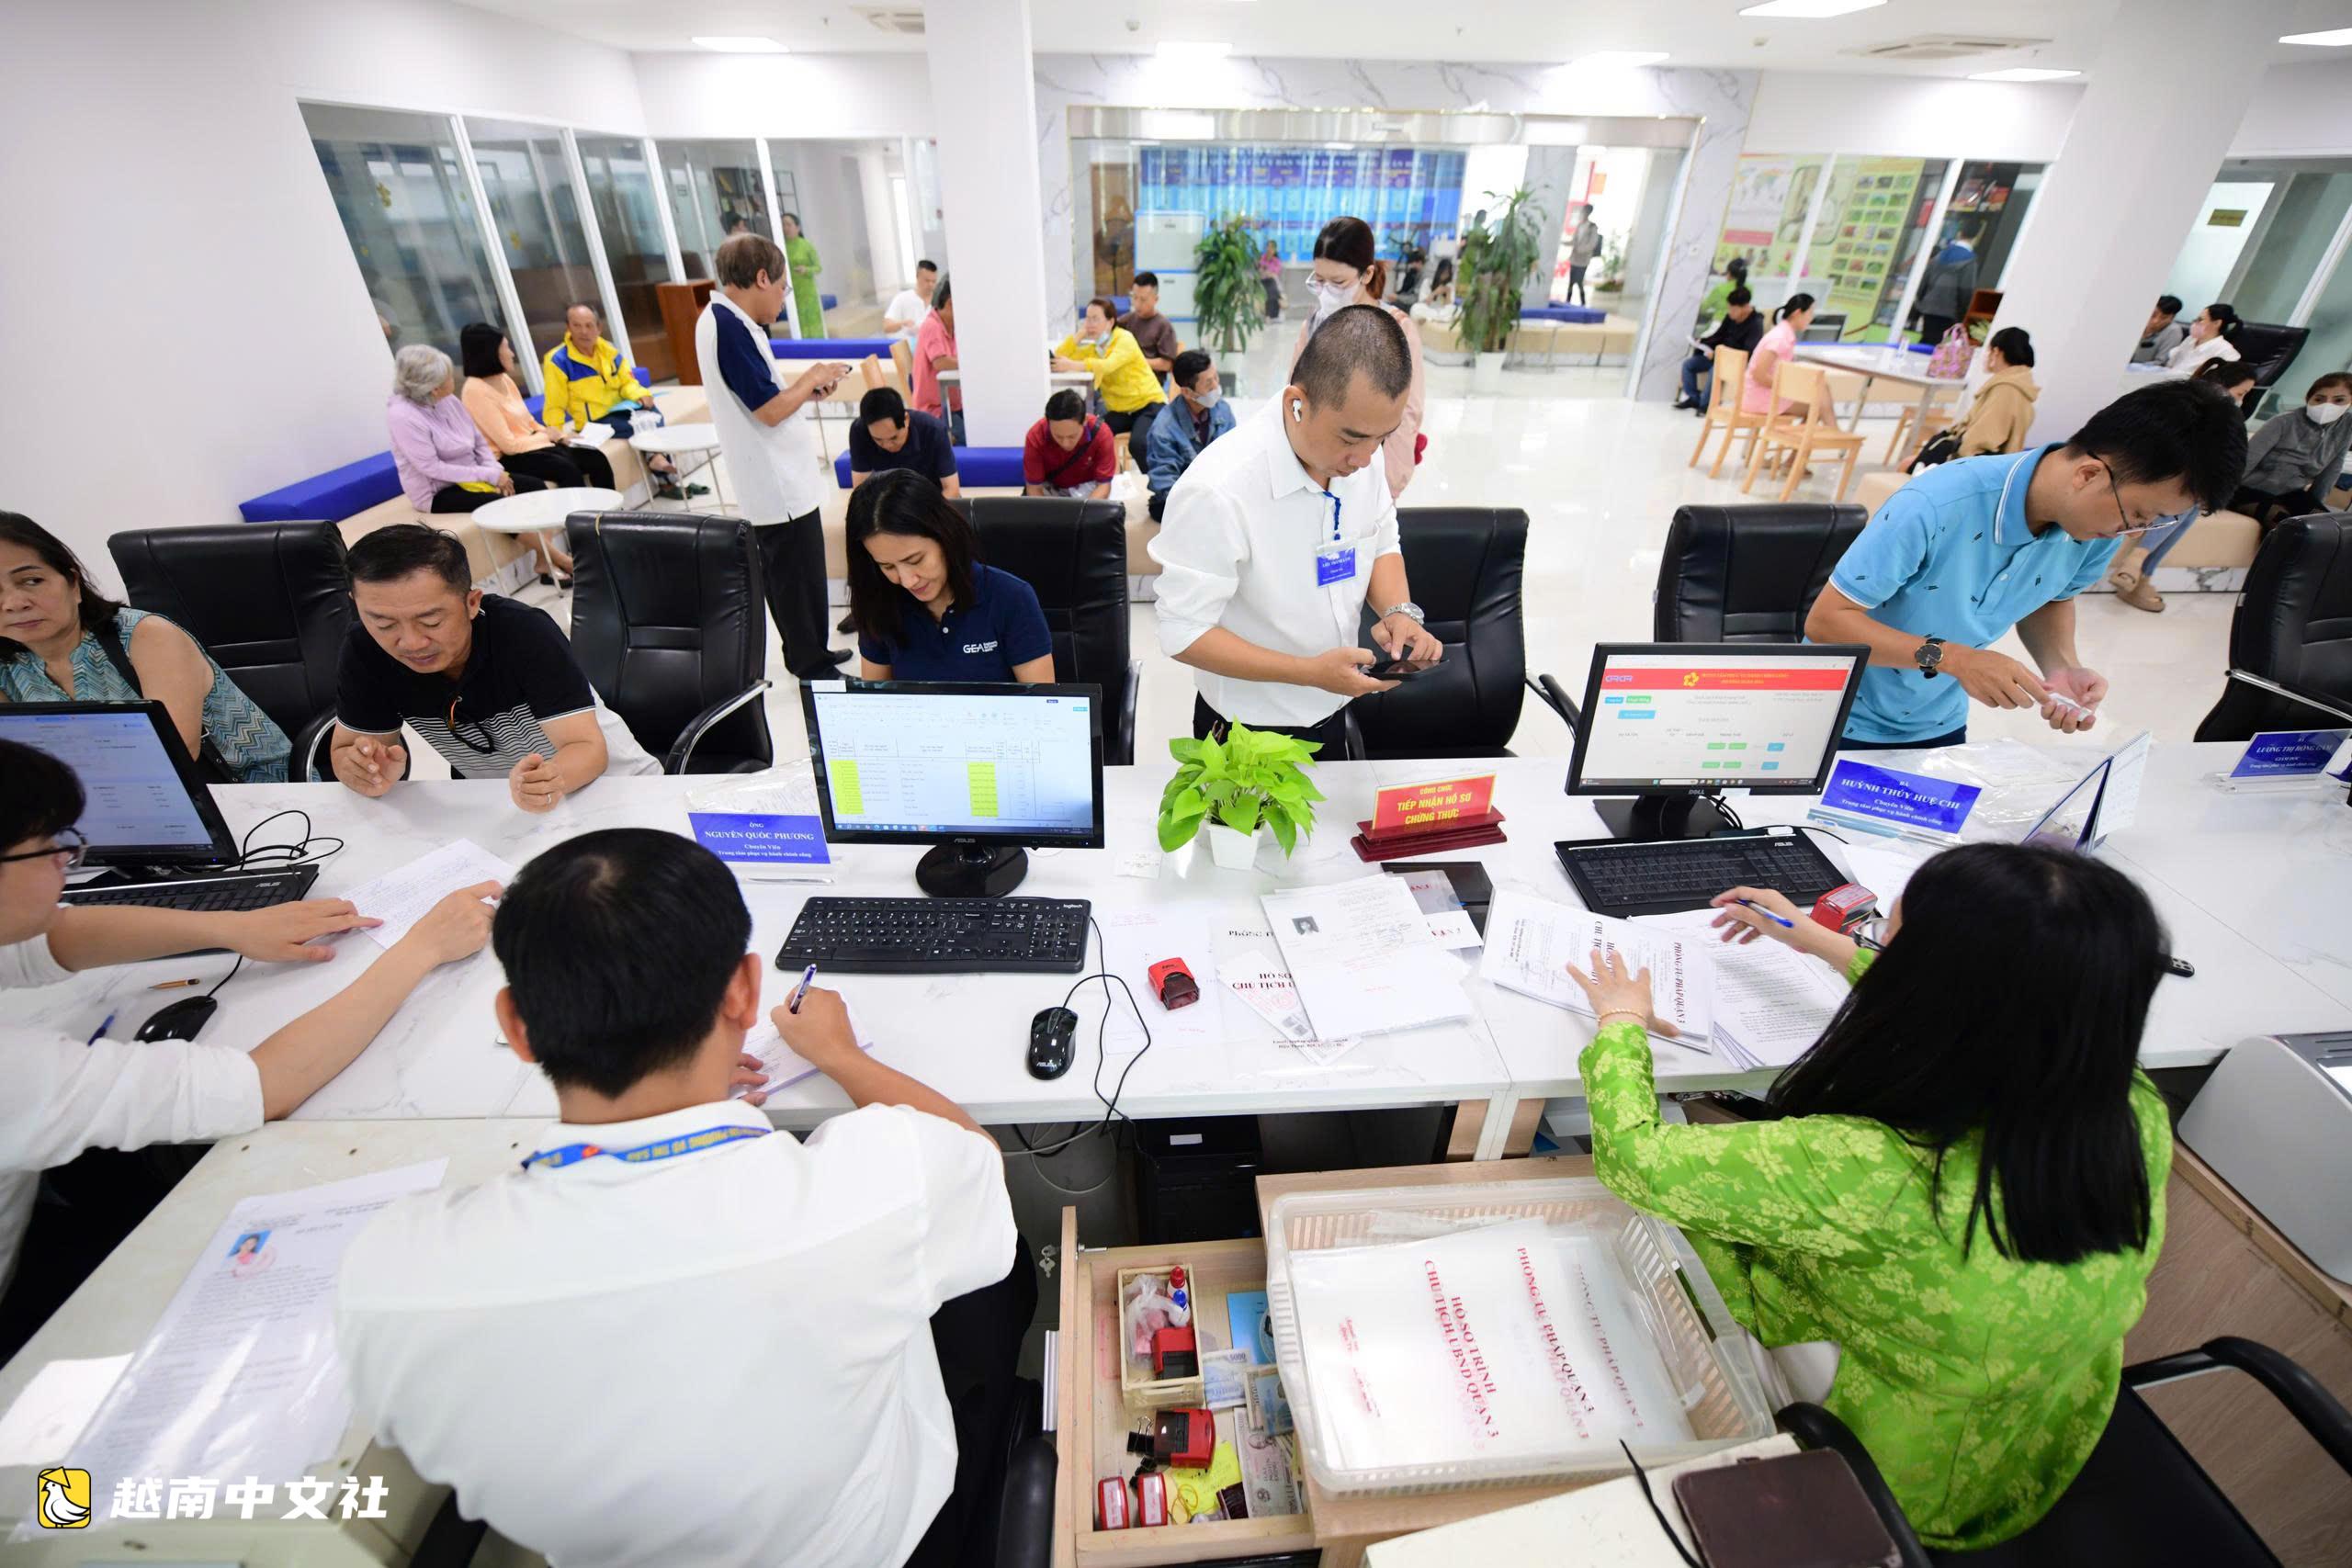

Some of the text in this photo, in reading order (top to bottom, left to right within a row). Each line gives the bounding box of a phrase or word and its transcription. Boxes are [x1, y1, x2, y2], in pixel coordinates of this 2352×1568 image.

[963, 643, 984, 653] GEA
[1397, 792, 1472, 812] TIẾP NHẬN HỒ SƠ
[1842, 799, 1859, 807] Trung
[1939, 799, 1961, 809] CHI
[775, 831, 815, 840] PHƯƠNG
[1517, 1247, 1541, 1296] PHÒNG
[1544, 1324, 1566, 1361] PHÁP
[1561, 1362, 1587, 1401] QUẬN
[1435, 1296, 1455, 1334] TỊCH
[1449, 1337, 1472, 1379] UBND
[1466, 1382, 1492, 1426] QUẬN
[1487, 1428, 1499, 1438] 3
[1470, 1347, 1497, 1393] TRÌNH
